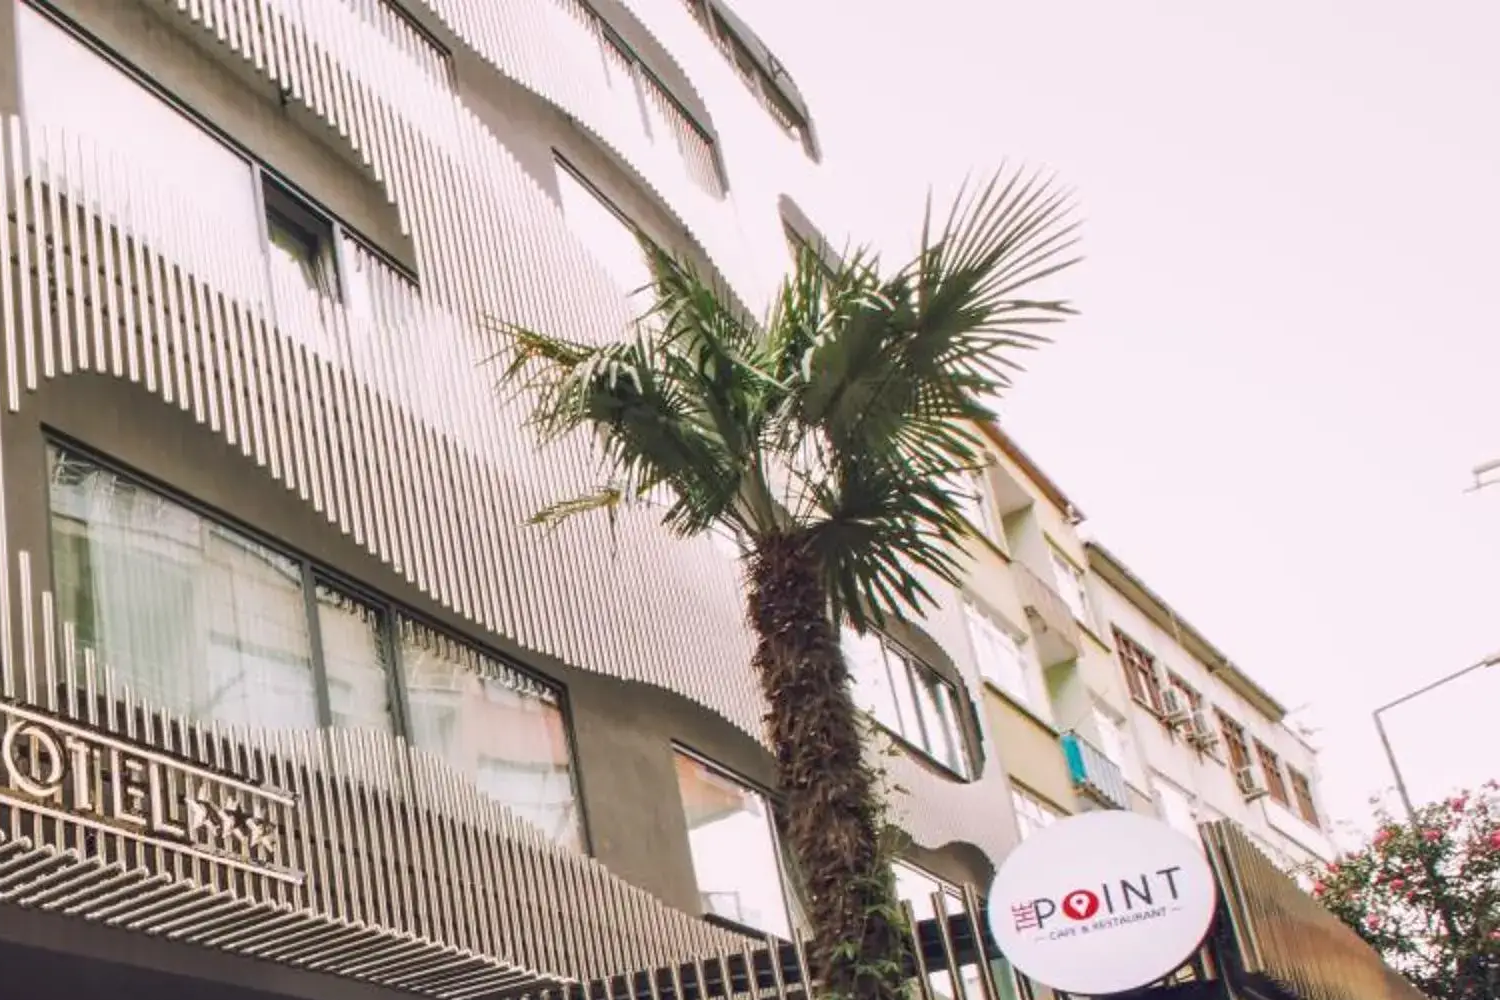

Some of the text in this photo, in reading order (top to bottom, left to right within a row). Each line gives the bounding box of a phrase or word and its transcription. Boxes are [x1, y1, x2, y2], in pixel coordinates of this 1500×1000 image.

[1033, 866, 1181, 929] POINT
[1011, 900, 1037, 932] THE
[1081, 923, 1090, 935] &
[1092, 906, 1167, 932] RESTAURANT
